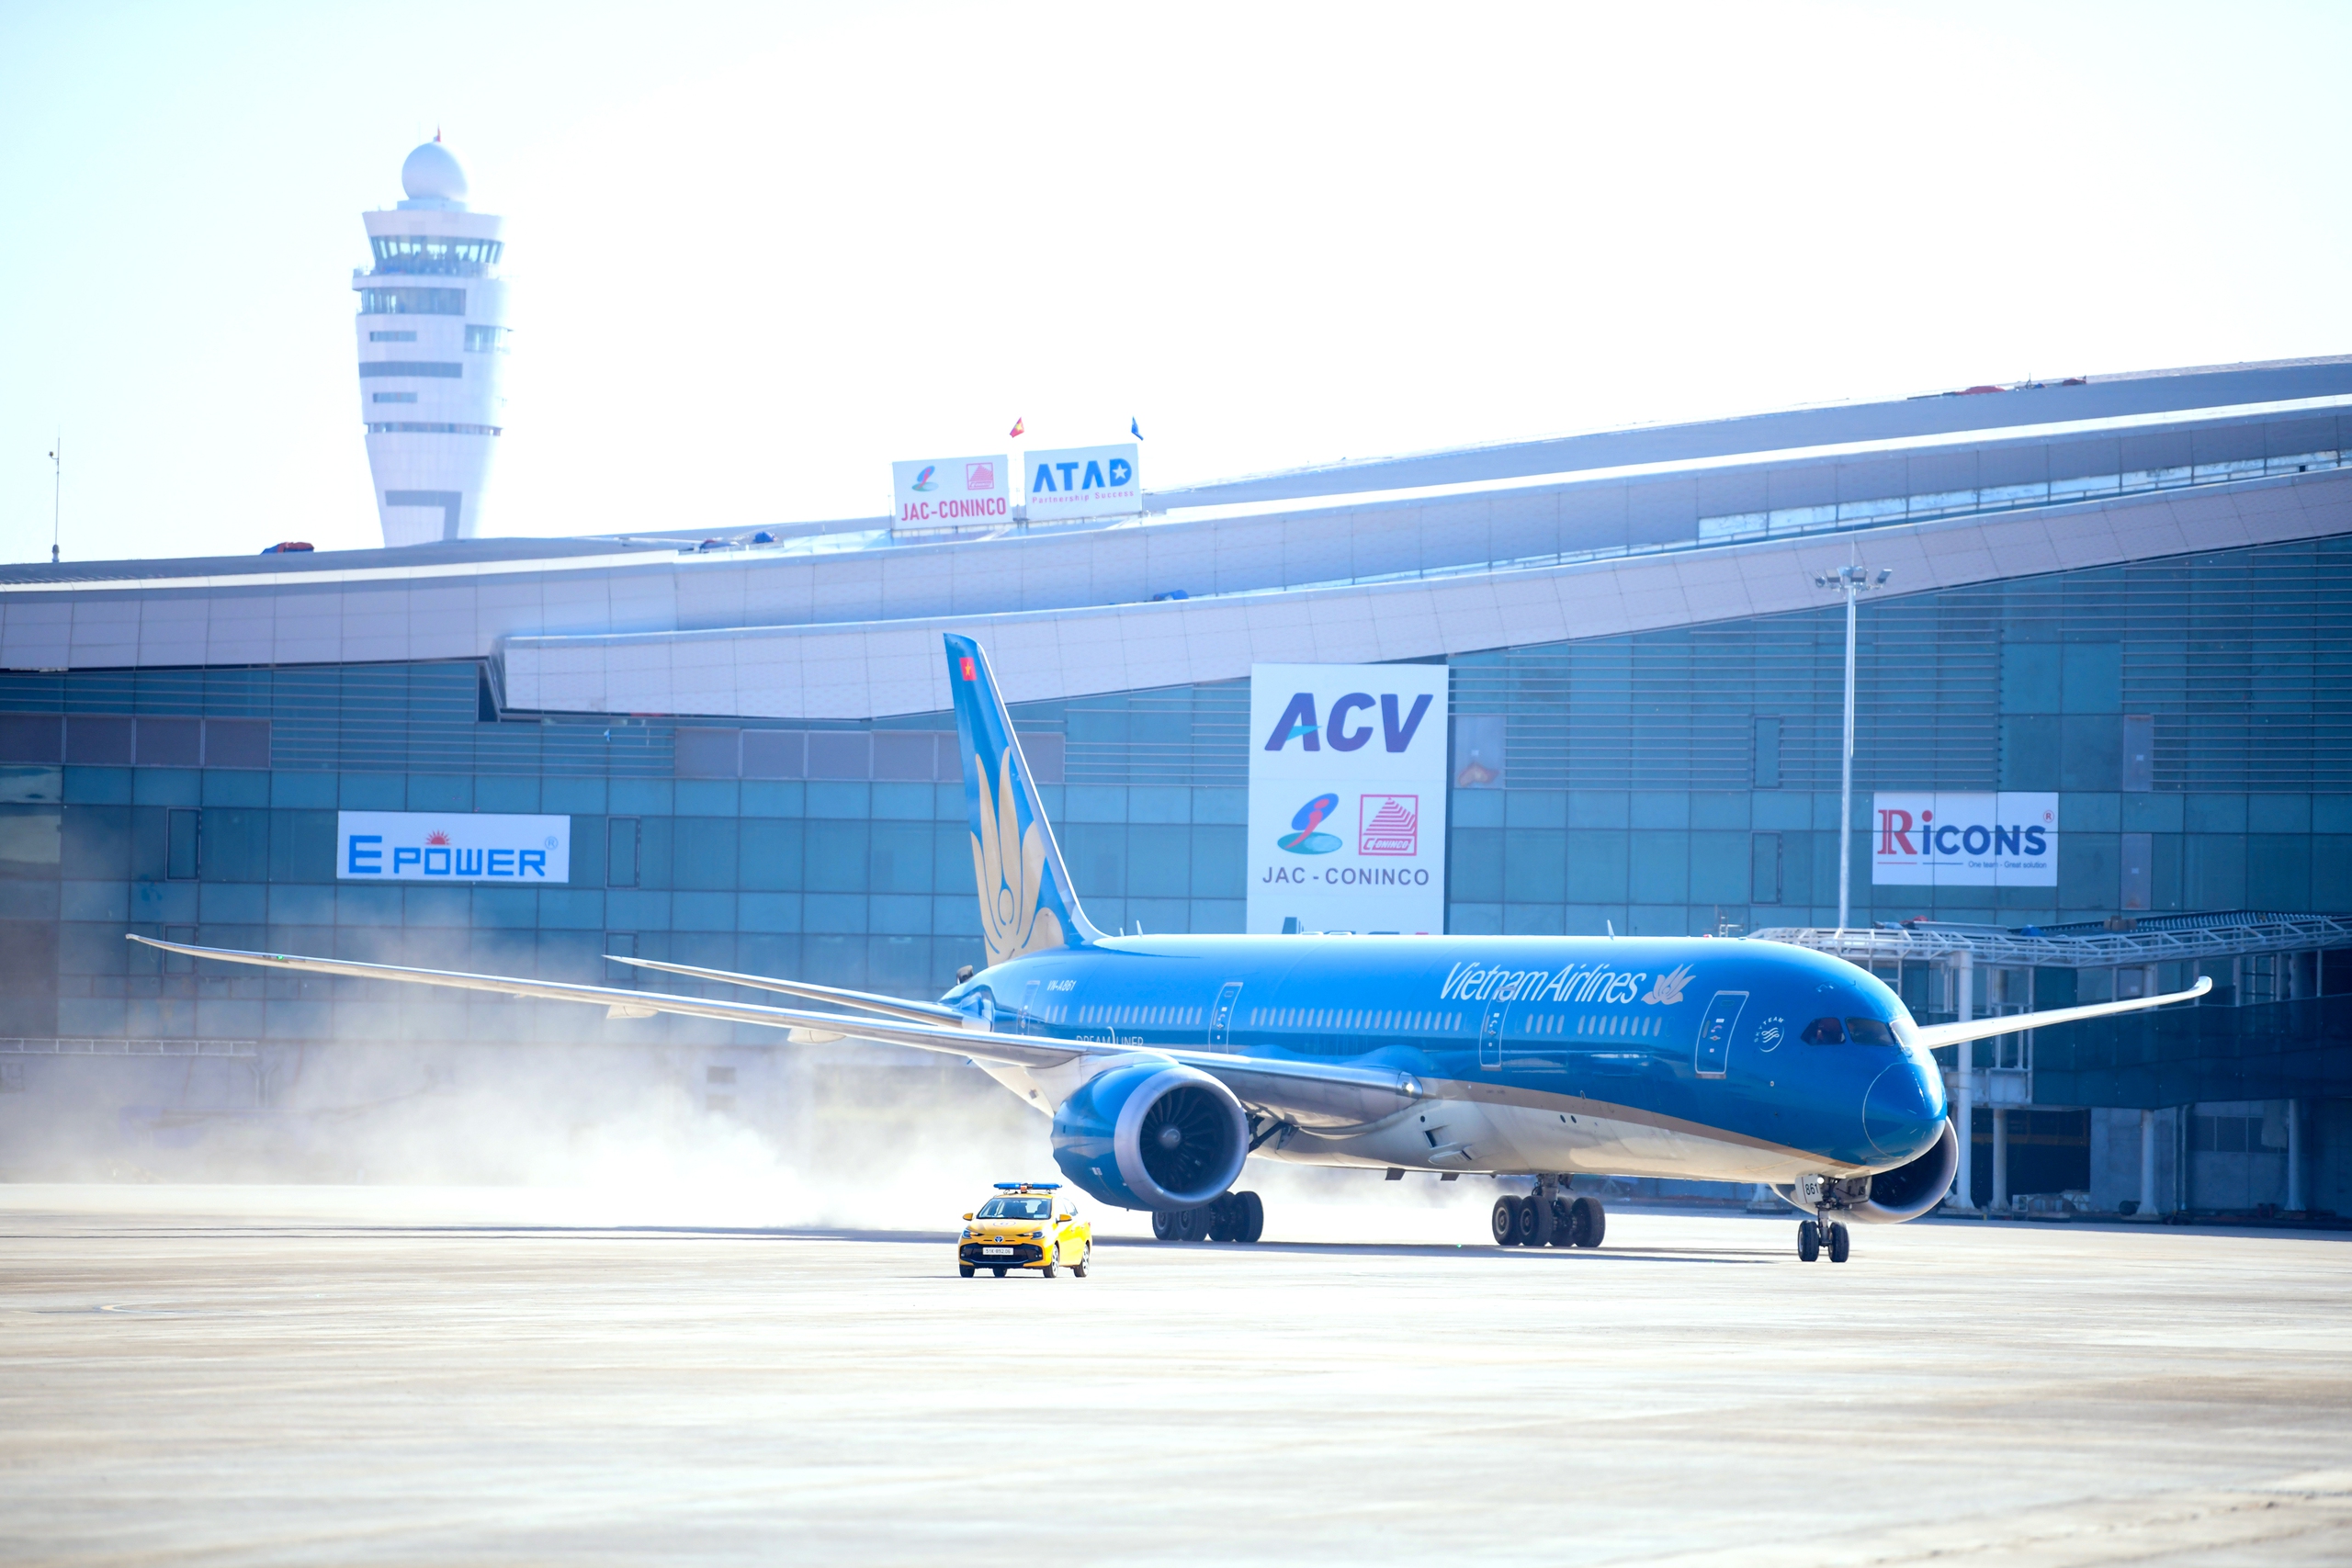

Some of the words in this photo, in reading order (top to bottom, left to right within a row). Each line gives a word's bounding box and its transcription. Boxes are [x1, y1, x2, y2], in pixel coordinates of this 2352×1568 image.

[1033, 458, 1132, 492] ATAD
[900, 496, 1007, 522] JAC-CONINCO
[1032, 493, 1090, 504] Partnership
[1094, 491, 1135, 500] Success
[1264, 692, 1433, 753] ACV
[393, 847, 546, 877] POWER
[1262, 867, 1306, 884] JAC
[1325, 868, 1430, 886] CONINCO
[1046, 980, 1077, 991] VN-A861
[1441, 962, 1549, 1000] Vietnam
[1544, 964, 1647, 1004] Airlines
[1804, 1182, 1819, 1196] 861
